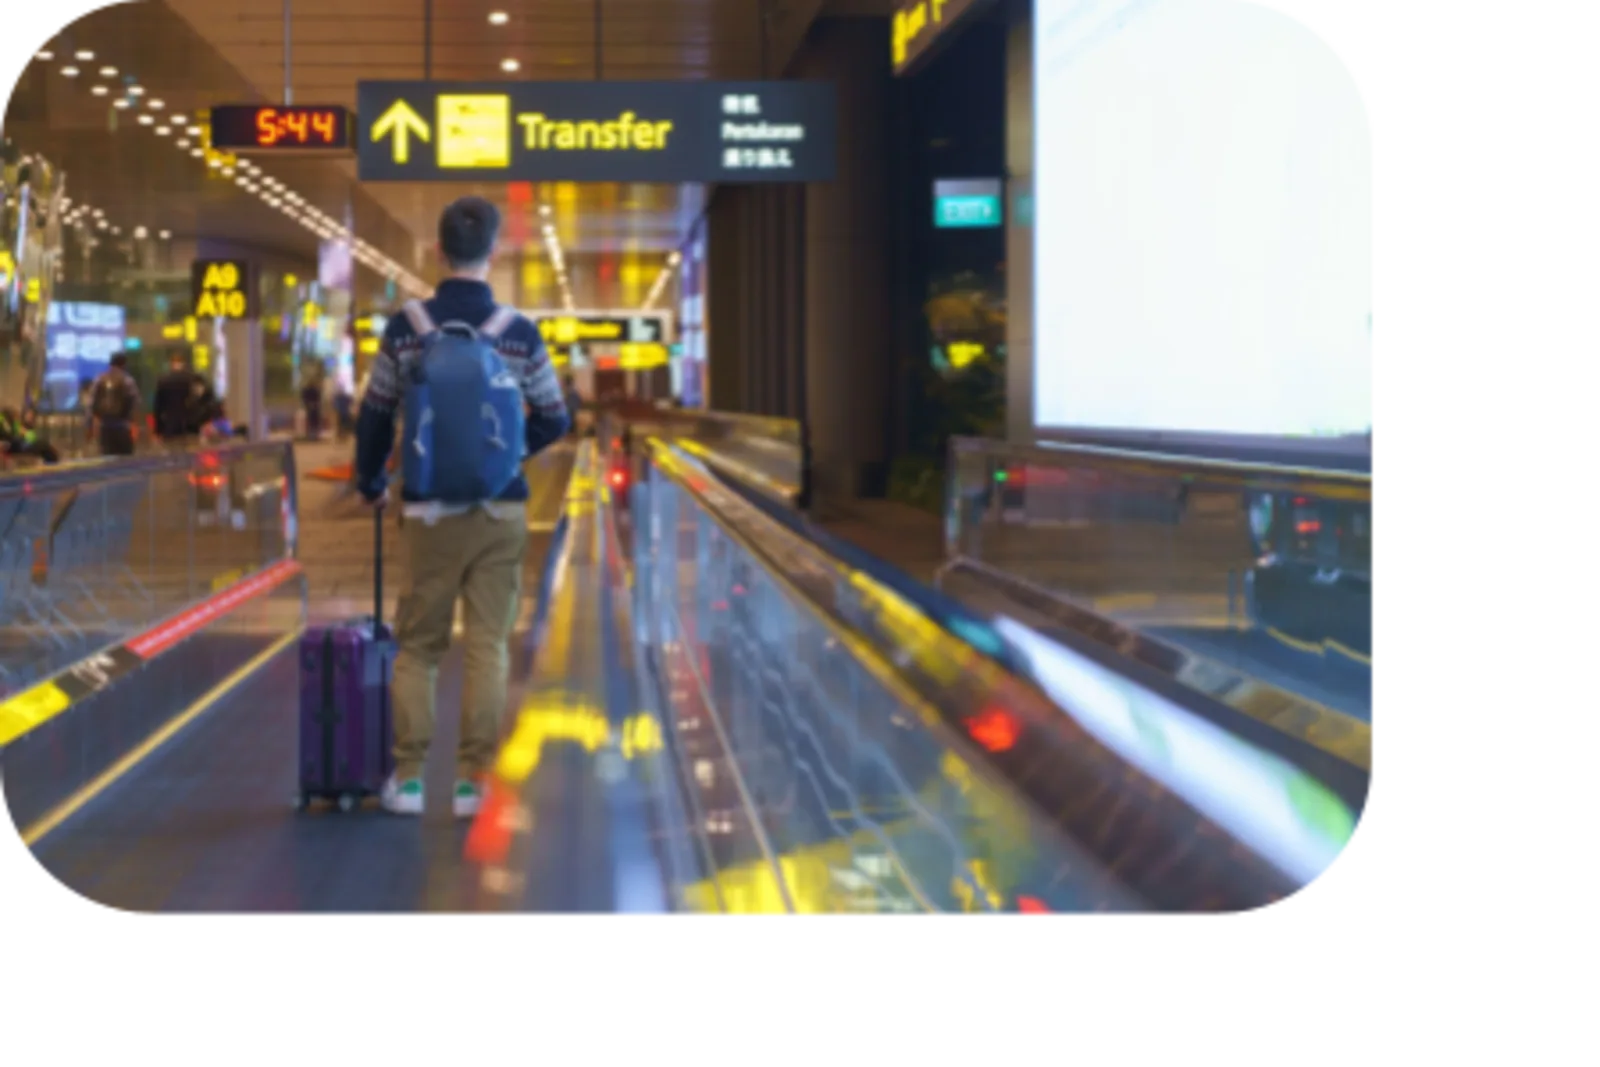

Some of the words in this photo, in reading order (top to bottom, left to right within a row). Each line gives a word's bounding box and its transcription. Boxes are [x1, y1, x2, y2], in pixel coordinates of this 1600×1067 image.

[257, 108, 336, 144] 5:44
[517, 110, 673, 149] Transfer
[196, 289, 246, 318] A10
